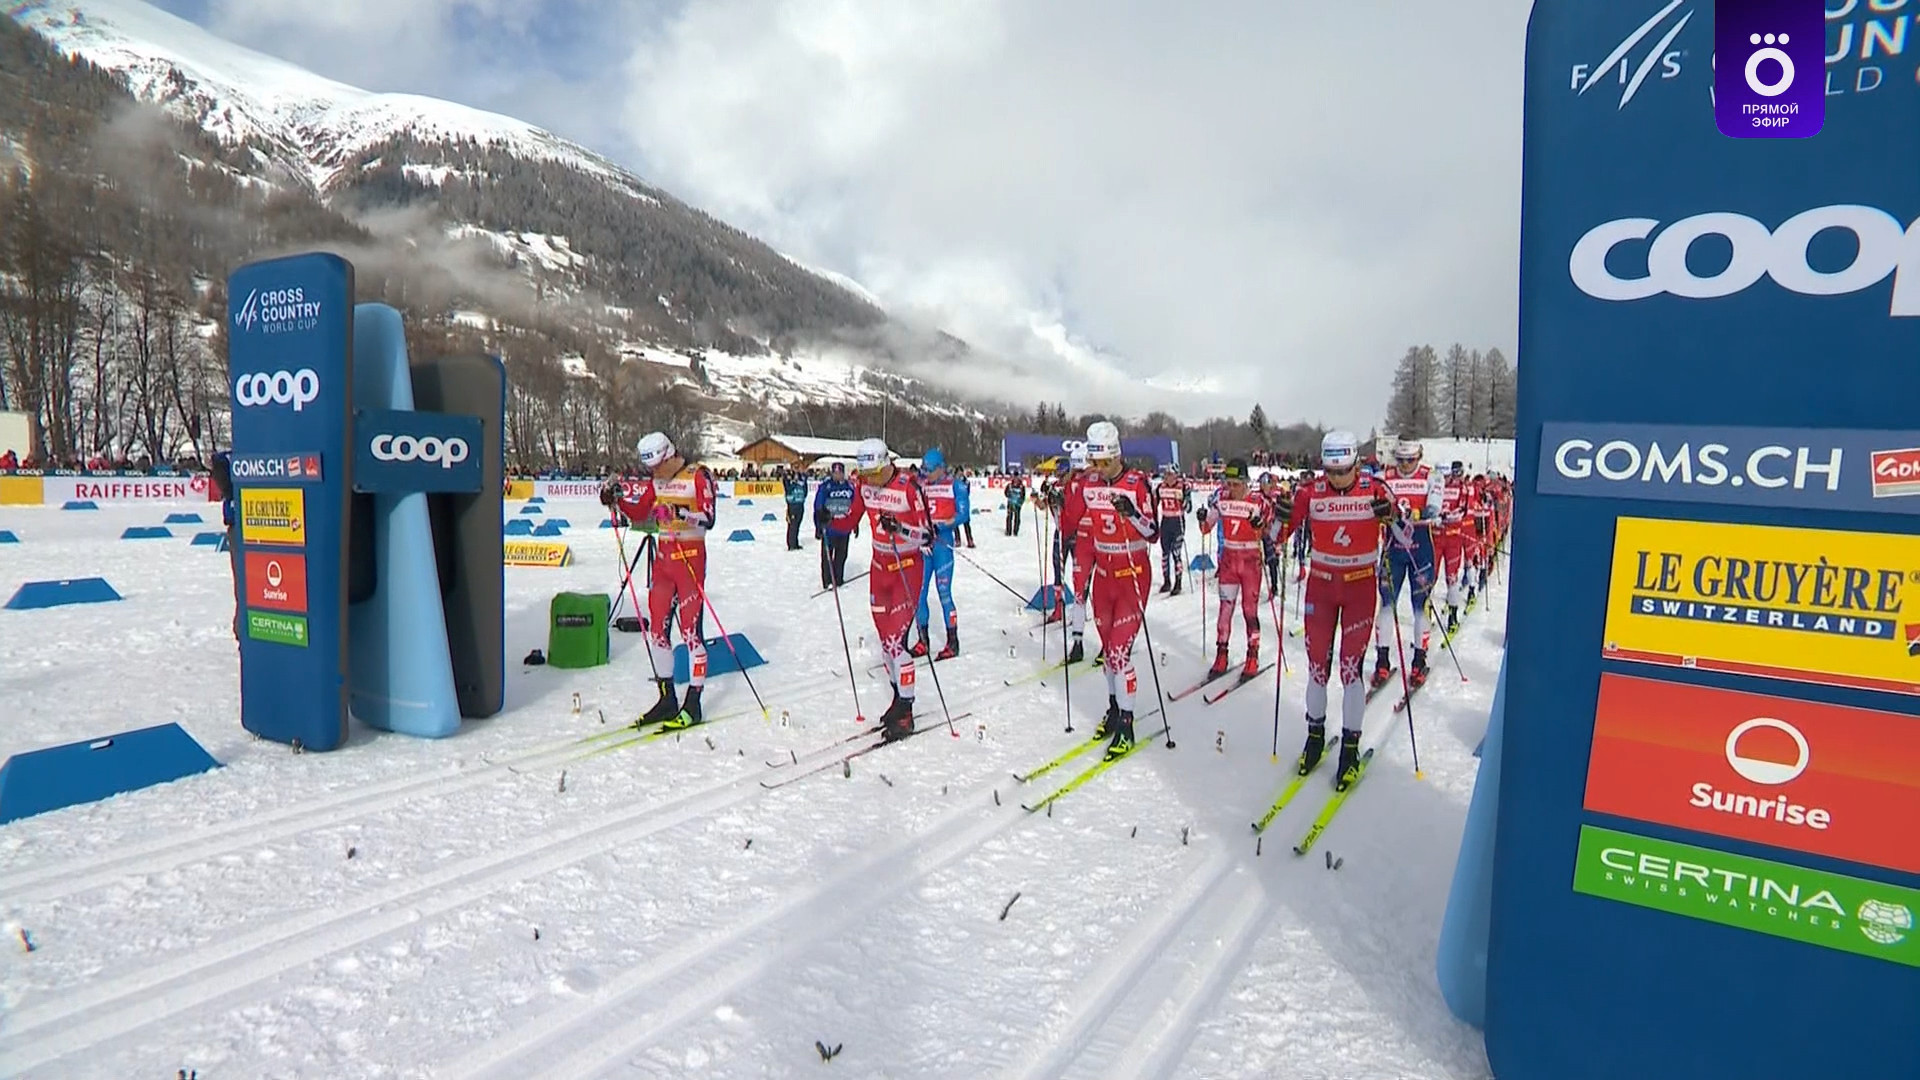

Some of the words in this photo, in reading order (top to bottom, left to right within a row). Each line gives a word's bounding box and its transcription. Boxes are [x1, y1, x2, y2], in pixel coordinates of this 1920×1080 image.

[1568, 204, 1920, 317] coo
[260, 287, 304, 306] CROSS
[261, 301, 321, 323] COUNTRY
[262, 320, 294, 334] WORLD
[297, 318, 318, 330] CUP
[236, 368, 319, 411] coop
[370, 434, 469, 468] coop
[232, 459, 284, 476] GOMS.CH
[1554, 439, 1843, 491] GOMS.CH
[75, 484, 185, 498] RAIFFEISEN
[547, 485, 600, 496] RAIFFEISEN
[755, 482, 774, 494] BKW
[872, 491, 903, 505] Sunrise
[928, 499, 937, 514] 5
[1163, 499, 1176, 509] 13
[1327, 501, 1370, 513] Sunrise
[245, 500, 254, 517] LE
[1100, 513, 1117, 535] 3
[1230, 519, 1240, 536] 7
[1333, 525, 1352, 547] 4
[1633, 551, 1683, 593] LE
[1692, 556, 1905, 613] GRUYÈRE
[263, 588, 288, 601] Sunrise
[251, 616, 294, 632] CERTINA
[1641, 599, 1883, 636] SWITZERLAND
[1689, 782, 1832, 830] Sunrise
[1600, 847, 1846, 917] CERTINA
[1605, 872, 1687, 897] SWISS
[1705, 893, 1841, 929] WATCHES
